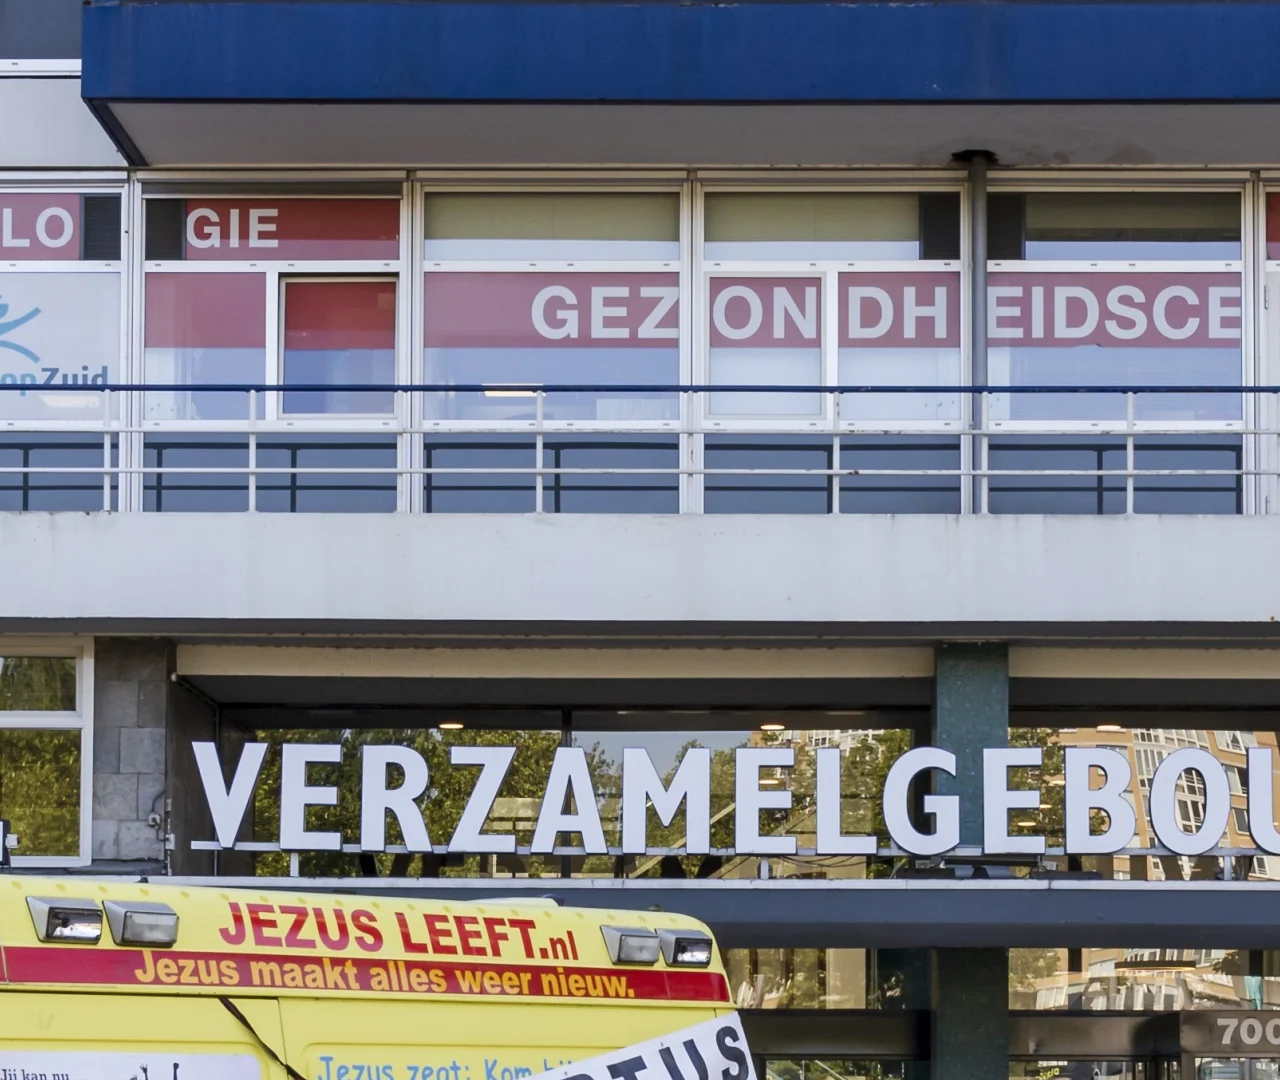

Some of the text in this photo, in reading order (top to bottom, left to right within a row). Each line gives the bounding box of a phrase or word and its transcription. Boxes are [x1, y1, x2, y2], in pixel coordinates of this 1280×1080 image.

[219, 901, 579, 961] JEZUS LEEFT.nl
[134, 948, 635, 999] Jezus maakt alles weer nieuw.
